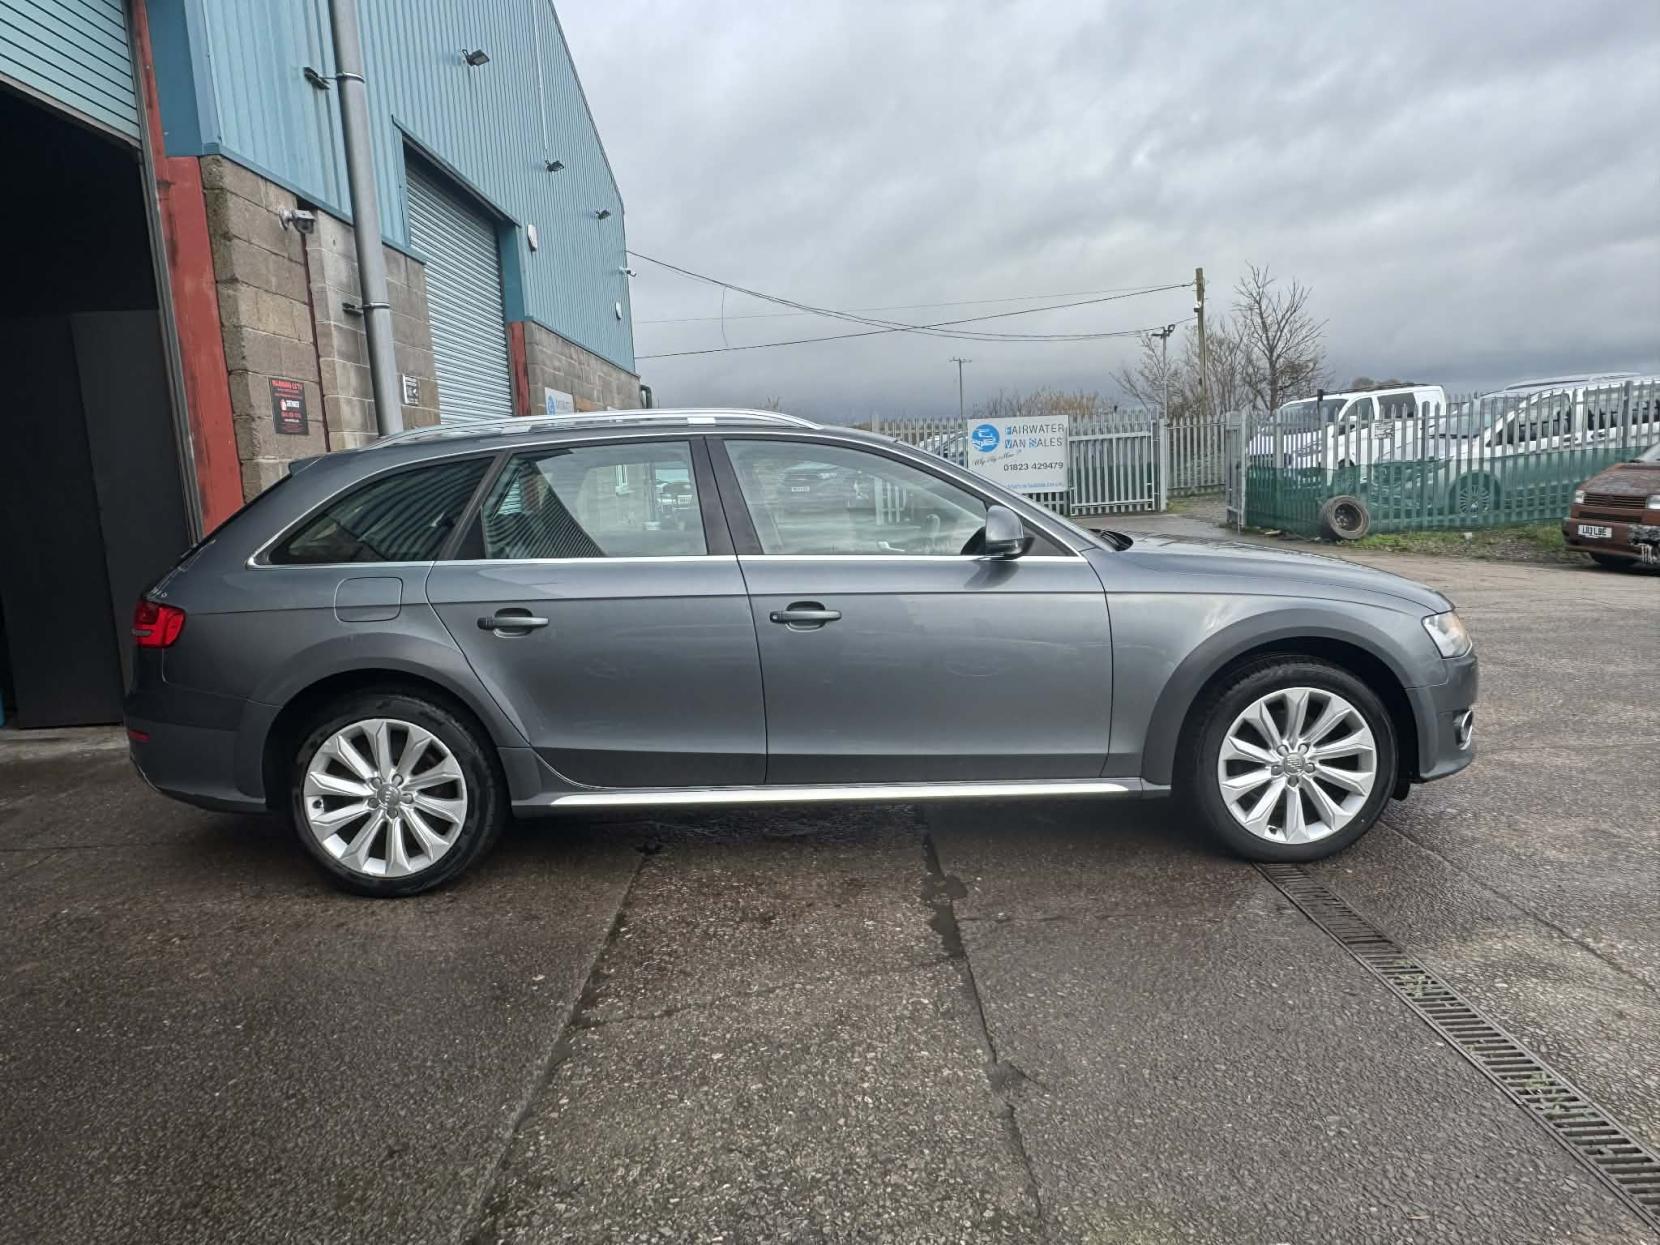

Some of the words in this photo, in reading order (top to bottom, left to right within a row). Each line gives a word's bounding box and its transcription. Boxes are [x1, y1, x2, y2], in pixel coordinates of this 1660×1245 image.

[1005, 438, 1026, 449] VAN
[1029, 437, 1063, 448] SALES
[1003, 463, 1029, 472] 01823
[1031, 461, 1063, 470] 429479
